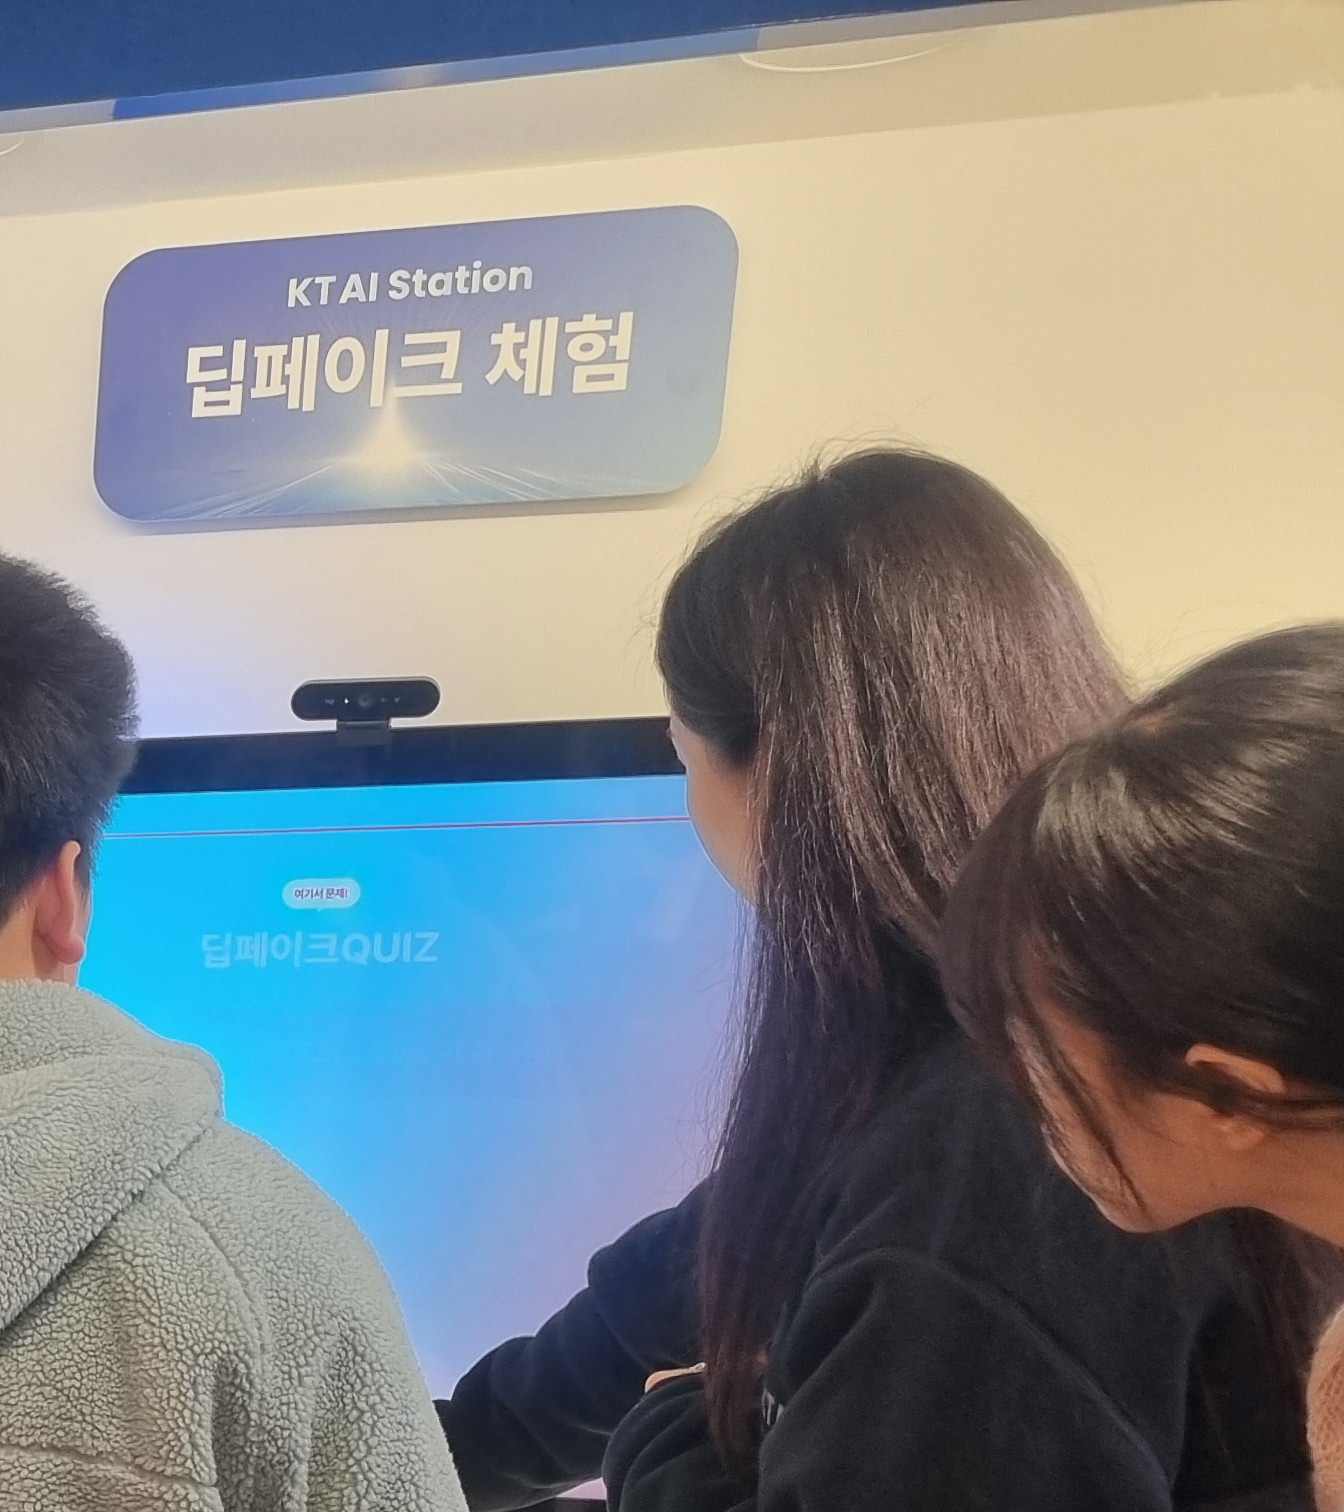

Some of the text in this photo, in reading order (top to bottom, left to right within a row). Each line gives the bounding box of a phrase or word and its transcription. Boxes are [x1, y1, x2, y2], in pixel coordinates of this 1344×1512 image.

[286, 259, 534, 308] KT AI Station
[185, 311, 635, 419] 딥페이크 체험
[294, 887, 324, 900] 여기서
[202, 931, 440, 968] 딥페이크QUIZ
